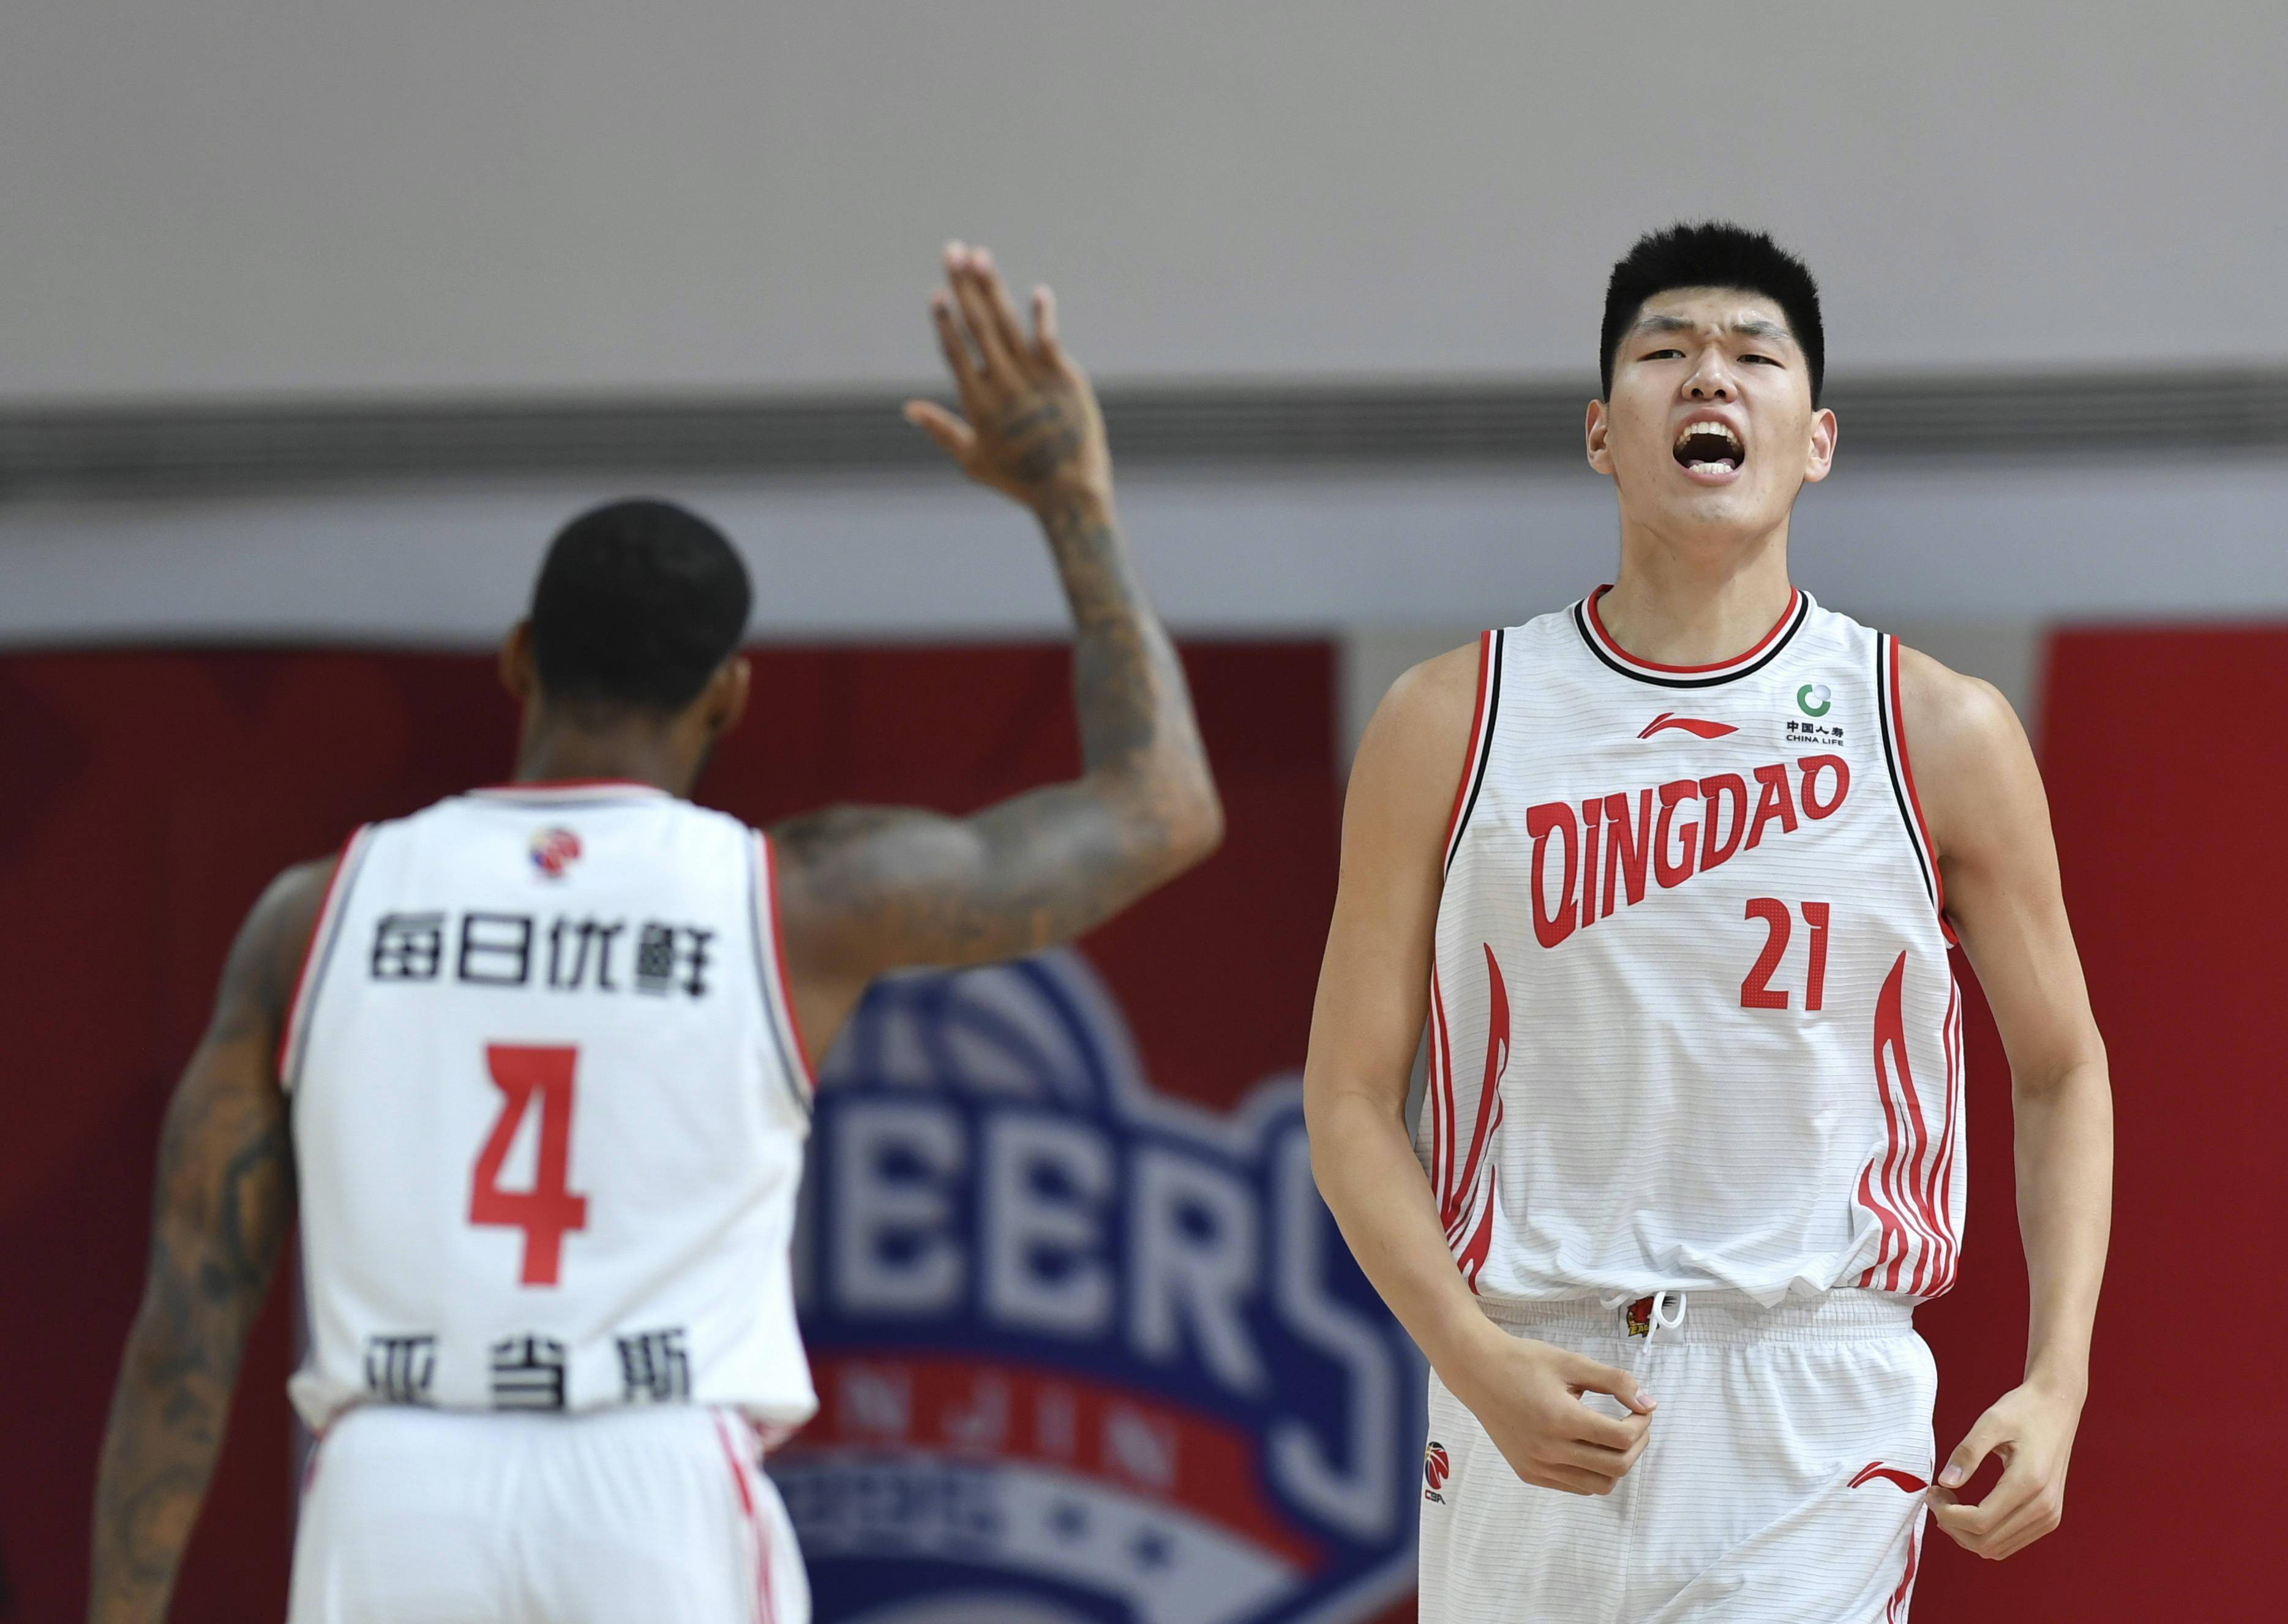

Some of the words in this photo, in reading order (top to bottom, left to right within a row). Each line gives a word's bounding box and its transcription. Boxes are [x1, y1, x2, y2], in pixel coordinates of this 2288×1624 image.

[1786, 720, 1844, 738] 中国人寿
[1786, 735, 1819, 743] CHINA
[1526, 754, 1850, 948] QINGDAO
[369, 911, 718, 999] 每日优鲜
[1740, 897, 1830, 1011] 21
[467, 1042, 589, 1287] 4
[794, 1099, 1396, 1540] EERS
